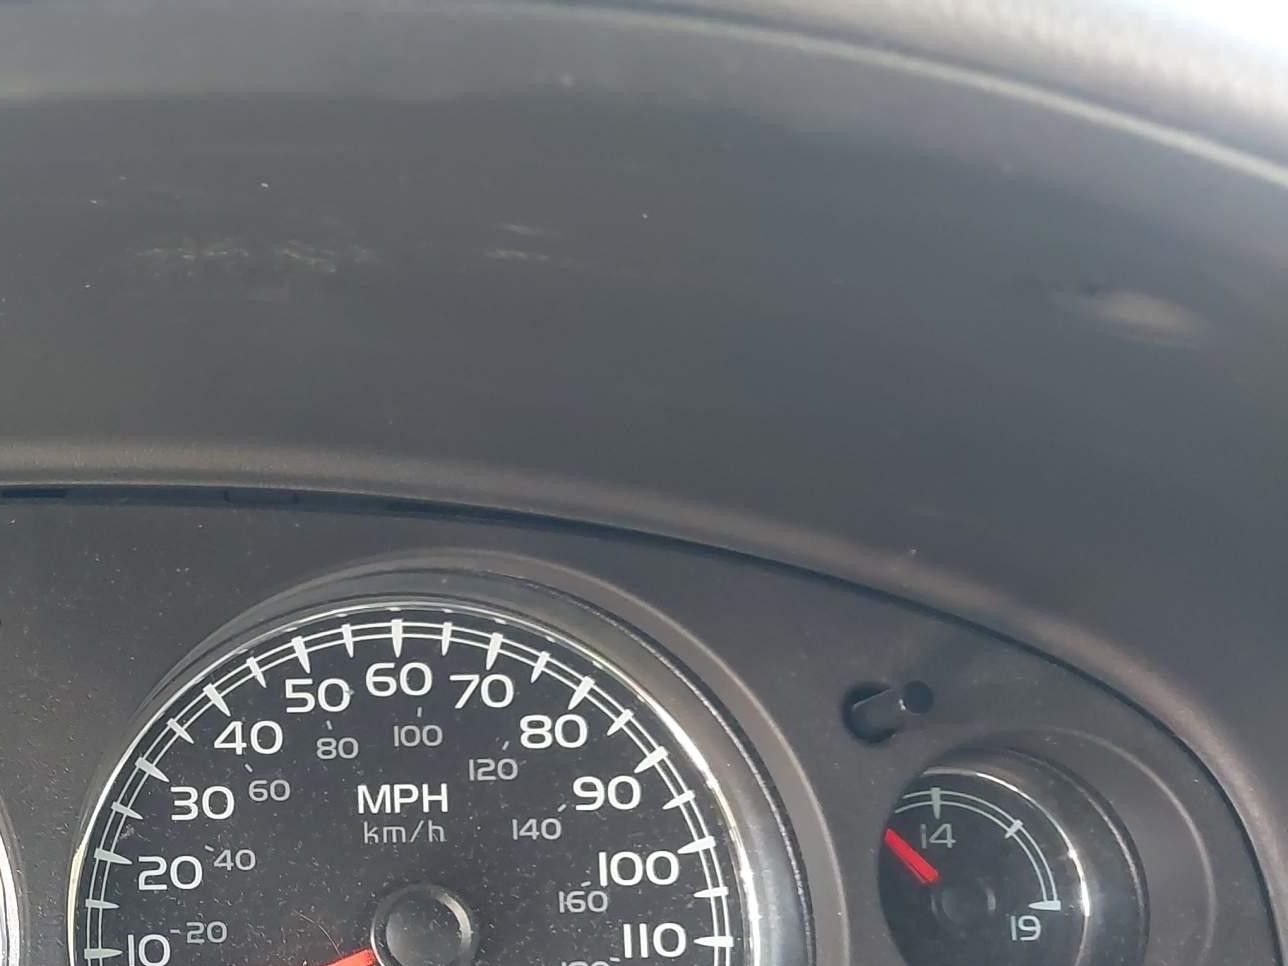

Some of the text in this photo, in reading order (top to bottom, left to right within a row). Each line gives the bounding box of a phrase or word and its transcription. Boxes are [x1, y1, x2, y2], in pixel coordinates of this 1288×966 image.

[365, 662, 433, 697] 60
[449, 674, 515, 709] 70
[285, 678, 352, 714] 50
[214, 720, 284, 755] 40
[393, 724, 443, 747] 100
[519, 713, 588, 750] 80
[316, 737, 360, 760] 80
[468, 758, 519, 781] 120
[170, 785, 235, 821] 30
[248, 779, 291, 802] 60
[357, 783, 449, 814] MPH
[572, 776, 641, 811] 90
[363, 820, 446, 845] km/h
[512, 818, 562, 841] 140
[921, 823, 957, 849] 14
[138, 856, 203, 891] 20
[214, 849, 256, 872] 40
[598, 851, 679, 886] 100
[559, 889, 608, 912] 160
[185, 925, 228, 945] 20
[623, 923, 687, 958] 110
[1010, 915, 1042, 941] 19
